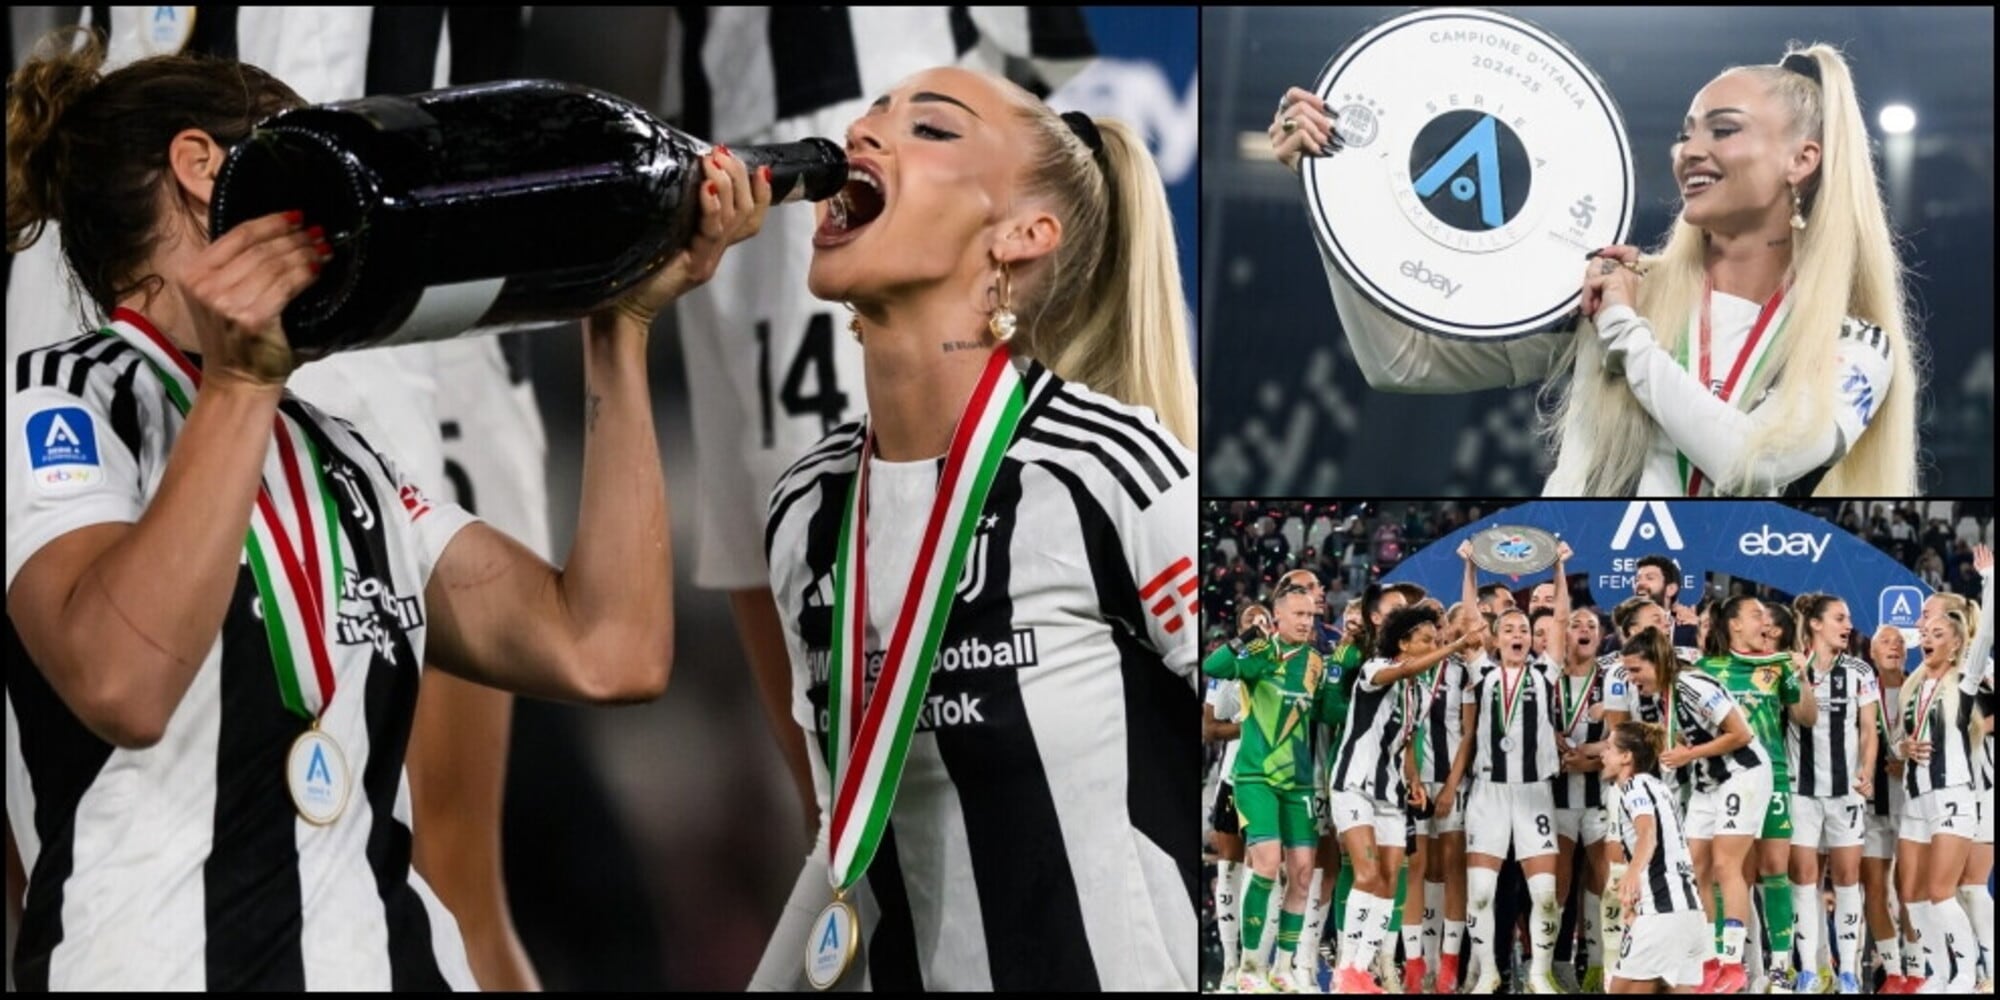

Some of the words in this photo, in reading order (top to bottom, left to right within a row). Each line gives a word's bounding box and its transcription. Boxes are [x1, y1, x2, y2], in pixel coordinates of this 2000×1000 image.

[1429, 31, 1521, 55] CAMPIONE
[1526, 51, 1586, 110] D'ITALIA
[1425, 94, 1526, 129] SERIE
[1400, 260, 1463, 299] ebay
[755, 312, 849, 450] 14
[1739, 525, 1832, 562] ebay
[1725, 793, 1741, 817] 9
[1535, 814, 1550, 836] 8
